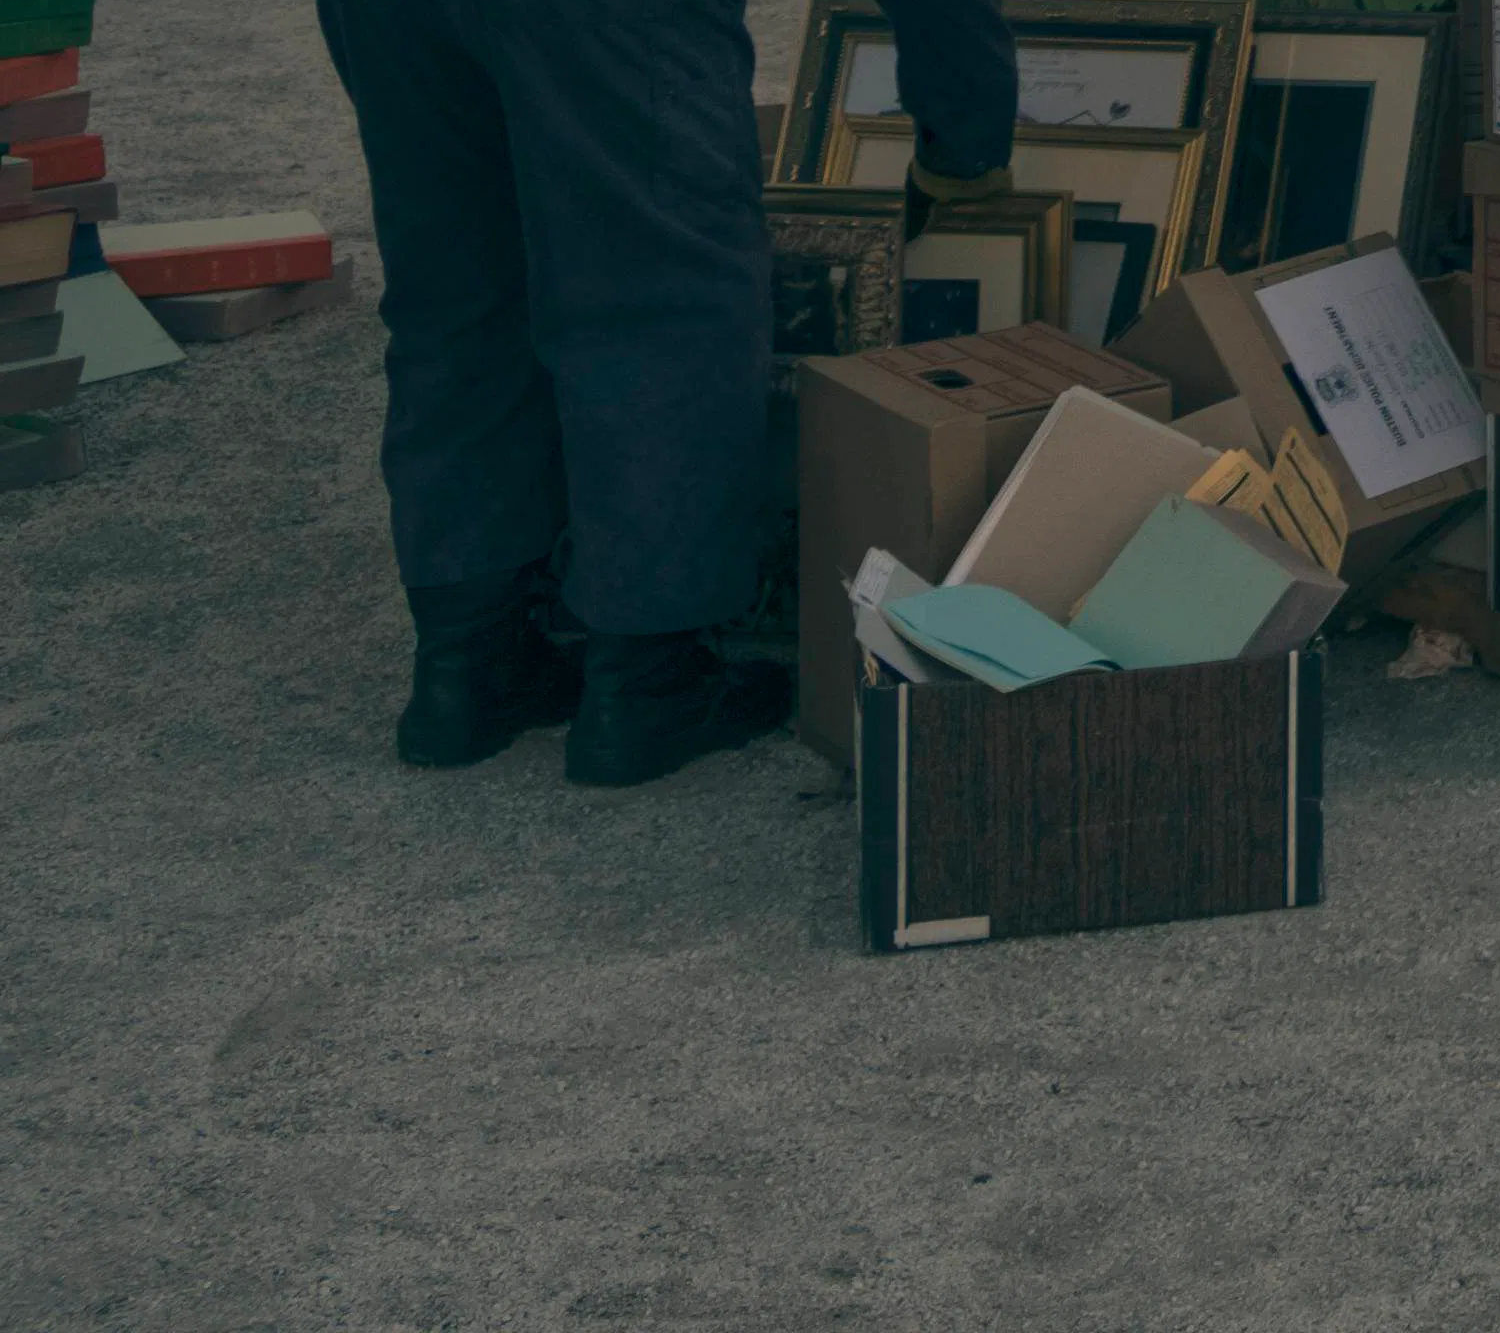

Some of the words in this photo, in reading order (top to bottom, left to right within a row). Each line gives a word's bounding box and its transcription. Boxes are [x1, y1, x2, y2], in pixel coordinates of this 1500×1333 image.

[1323, 304, 1366, 371] DEPARTMENT
[1359, 370, 1385, 408] POLICE
[1377, 405, 1408, 448] BOSTON
